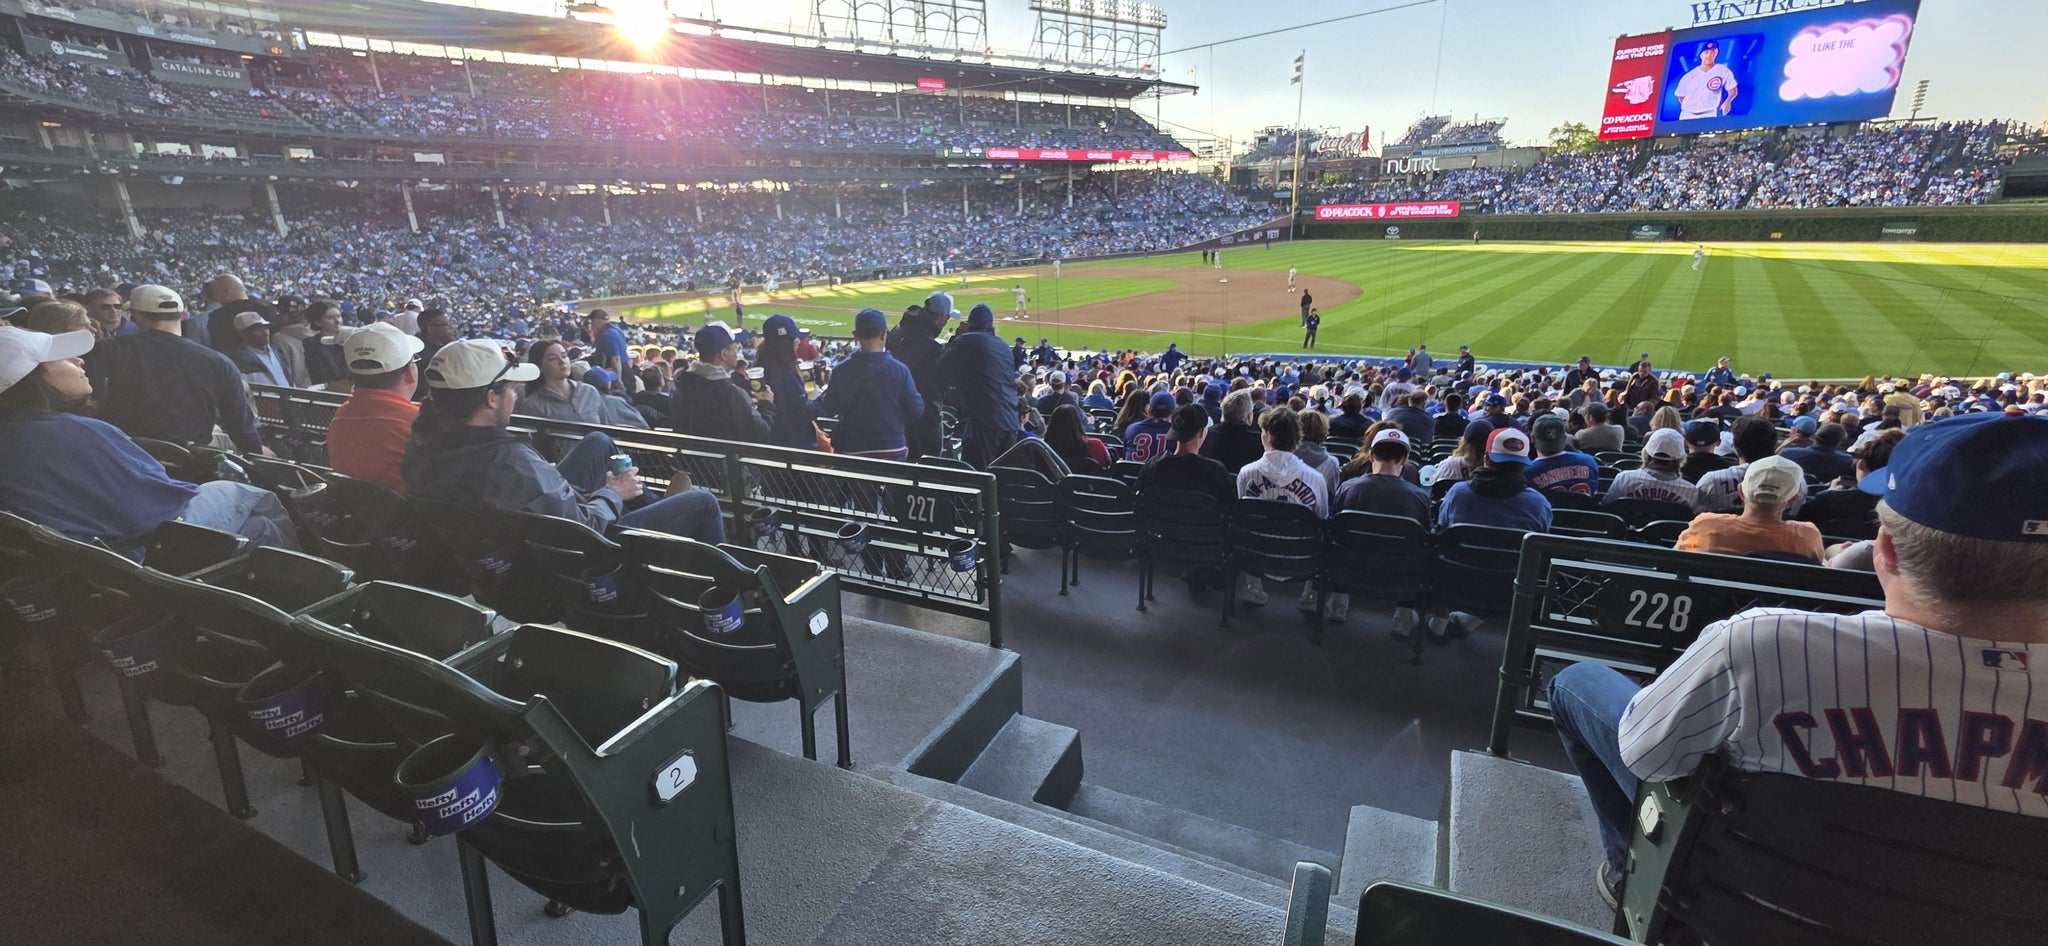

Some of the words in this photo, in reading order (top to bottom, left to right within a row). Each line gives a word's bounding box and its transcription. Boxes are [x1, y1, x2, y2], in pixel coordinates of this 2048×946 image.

[1616, 47, 1646, 56] CURIOUS
[1817, 41, 1837, 52] LIKE
[1839, 39, 1856, 49] THE
[161, 62, 212, 76] CATALINA
[215, 69, 241, 79] CLUB
[1614, 113, 1653, 124] PEACOCK
[1332, 206, 1373, 217] PEACOCK
[1266, 229, 1280, 240] YETI
[1132, 433, 1167, 462] 31
[1533, 465, 1591, 488] SANDBERG
[907, 494, 936, 523] 227
[1624, 589, 1692, 633] 228
[267, 714, 302, 730] Hefty
[288, 716, 321, 735] Hefty
[670, 767, 685, 789] 2
[417, 791, 455, 808] Hefty
[440, 793, 478, 817] Hefty
[465, 793, 495, 820] Hefty
